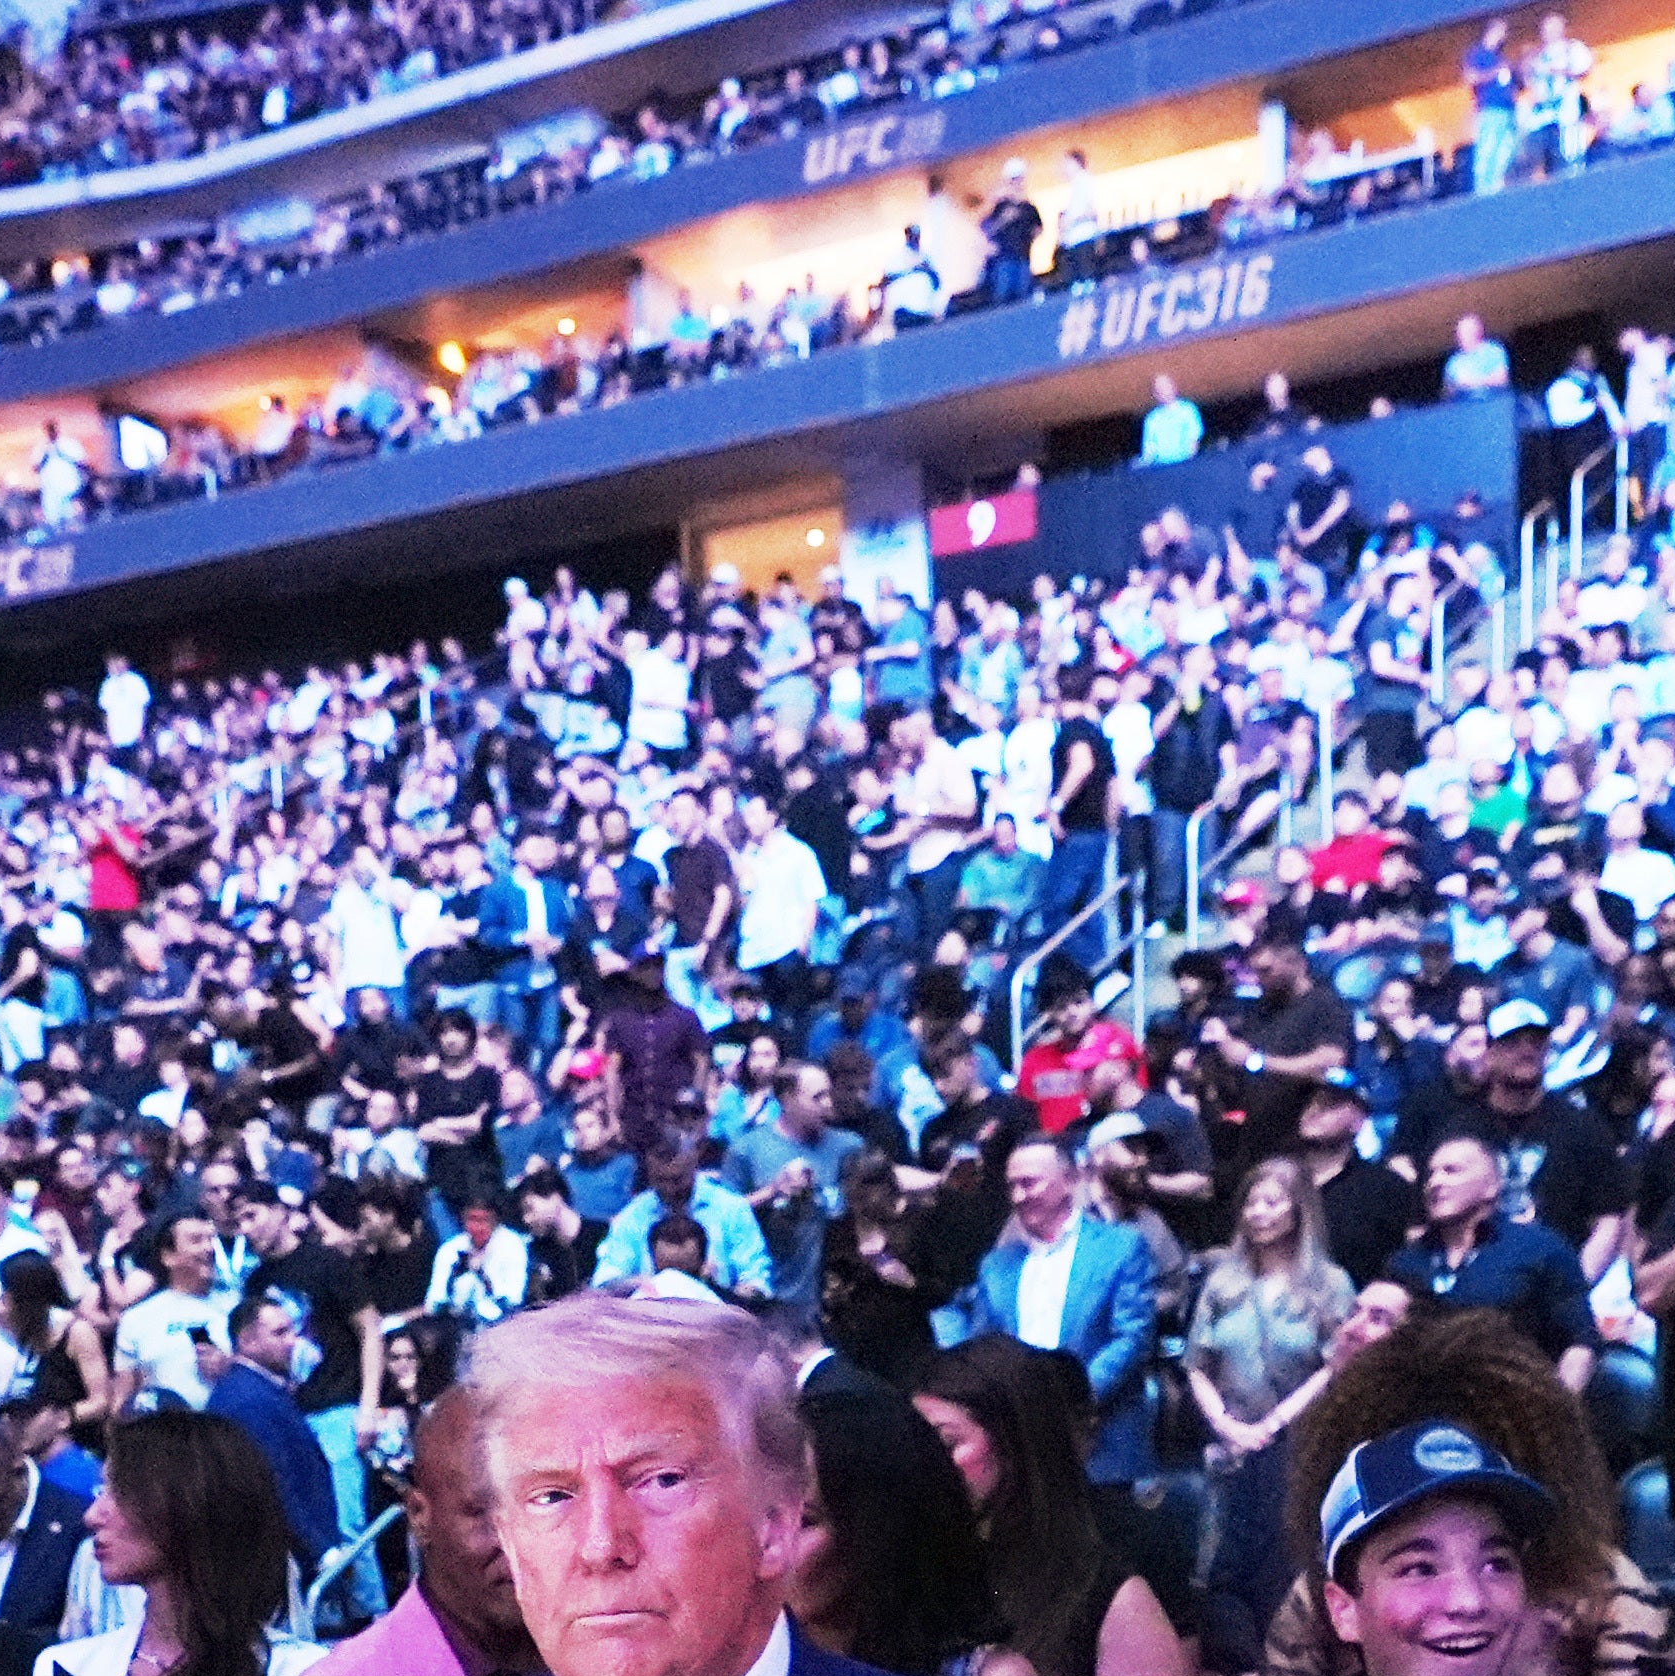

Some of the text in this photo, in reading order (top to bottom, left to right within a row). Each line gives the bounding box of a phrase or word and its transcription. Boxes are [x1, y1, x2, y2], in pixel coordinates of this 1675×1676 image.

[803, 115, 897, 182] UFC
[1058, 254, 1273, 358] #UFC316
[967, 500, 996, 547] 9
